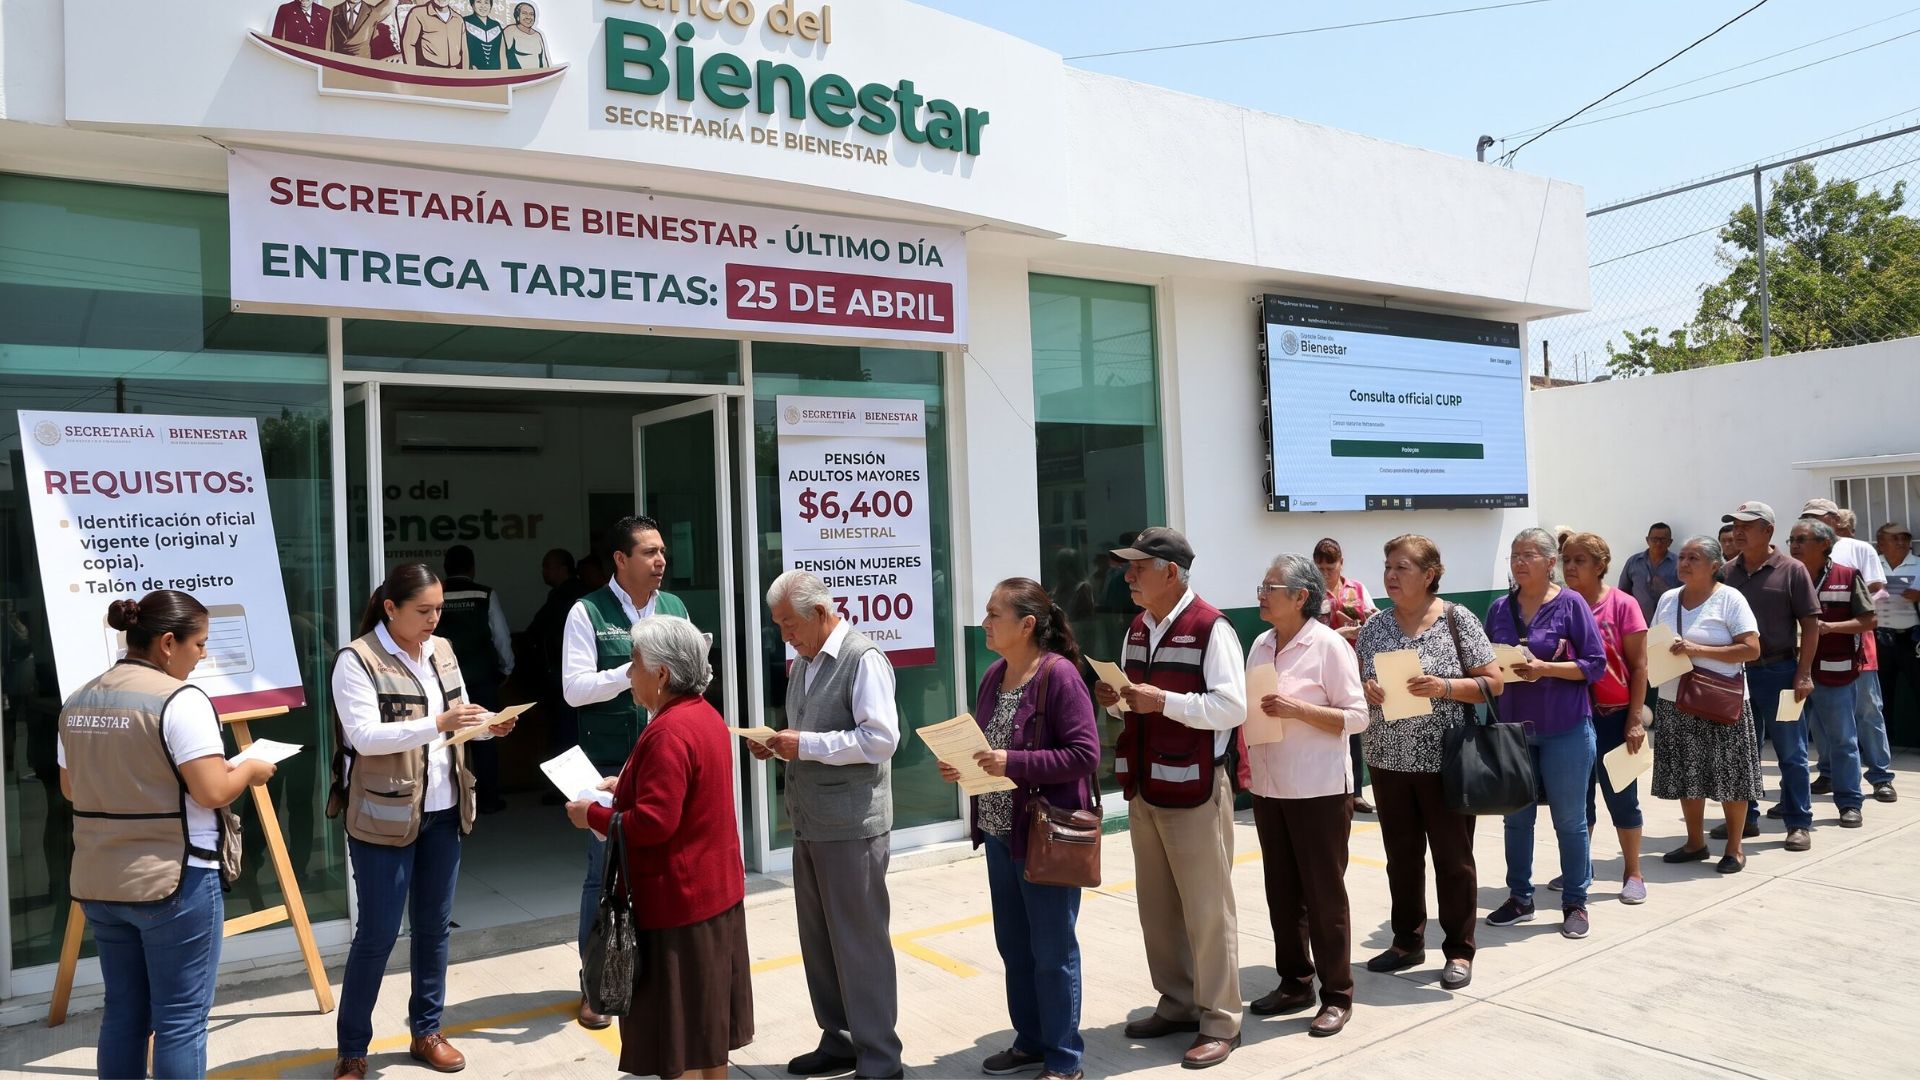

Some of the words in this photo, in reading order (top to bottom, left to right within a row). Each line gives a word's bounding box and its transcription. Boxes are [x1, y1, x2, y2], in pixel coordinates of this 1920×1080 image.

[768, 5, 831, 44] del
[605, 16, 989, 156] Bienestar
[605, 105, 744, 142] SECRETARÍA
[751, 127, 778, 147] DE
[784, 132, 888, 166] BIENESTAR
[270, 176, 513, 227] SECRETARÍA
[523, 202, 571, 232] DE
[582, 208, 758, 249] BIENESTAR
[785, 224, 890, 262] ÚLTIMO
[898, 238, 944, 267] DÍA
[262, 242, 489, 291] ENTREGA
[501, 261, 718, 306] TARJETAS:
[736, 278, 777, 310] 25
[789, 283, 836, 314] DE
[846, 288, 945, 322] ABRIL
[1301, 340, 1347, 355] Bienestar
[1349, 389, 1395, 403] Consulta
[1398, 392, 1433, 405] official
[1436, 394, 1462, 407] CURP
[865, 411, 918, 422] BIENESTAR
[65, 425, 155, 438] SECRETARÍA
[169, 428, 248, 440] BIENESTAR
[825, 451, 885, 465] PENSIÓN
[44, 470, 254, 499] REQUISITOS:
[788, 470, 853, 482] ADULTOS
[857, 470, 920, 482] MAYORES
[798, 487, 913, 524] $6,400
[78, 512, 200, 530] Identificación
[206, 512, 256, 526] oficial
[80, 535, 150, 552] vigente
[155, 532, 225, 550] (original
[228, 534, 238, 548] y
[820, 527, 896, 539] BIMESTRAL
[83, 554, 144, 572] copia).
[795, 556, 856, 572] PENSIÓN
[861, 556, 921, 569] MUJERES
[85, 578, 136, 594] Talón
[142, 577, 164, 591] de
[169, 574, 234, 591] registro
[823, 573, 897, 588] BIENESTAR
[833, 593, 913, 626] 3,100
[67, 715, 130, 729] BIENESTAR
